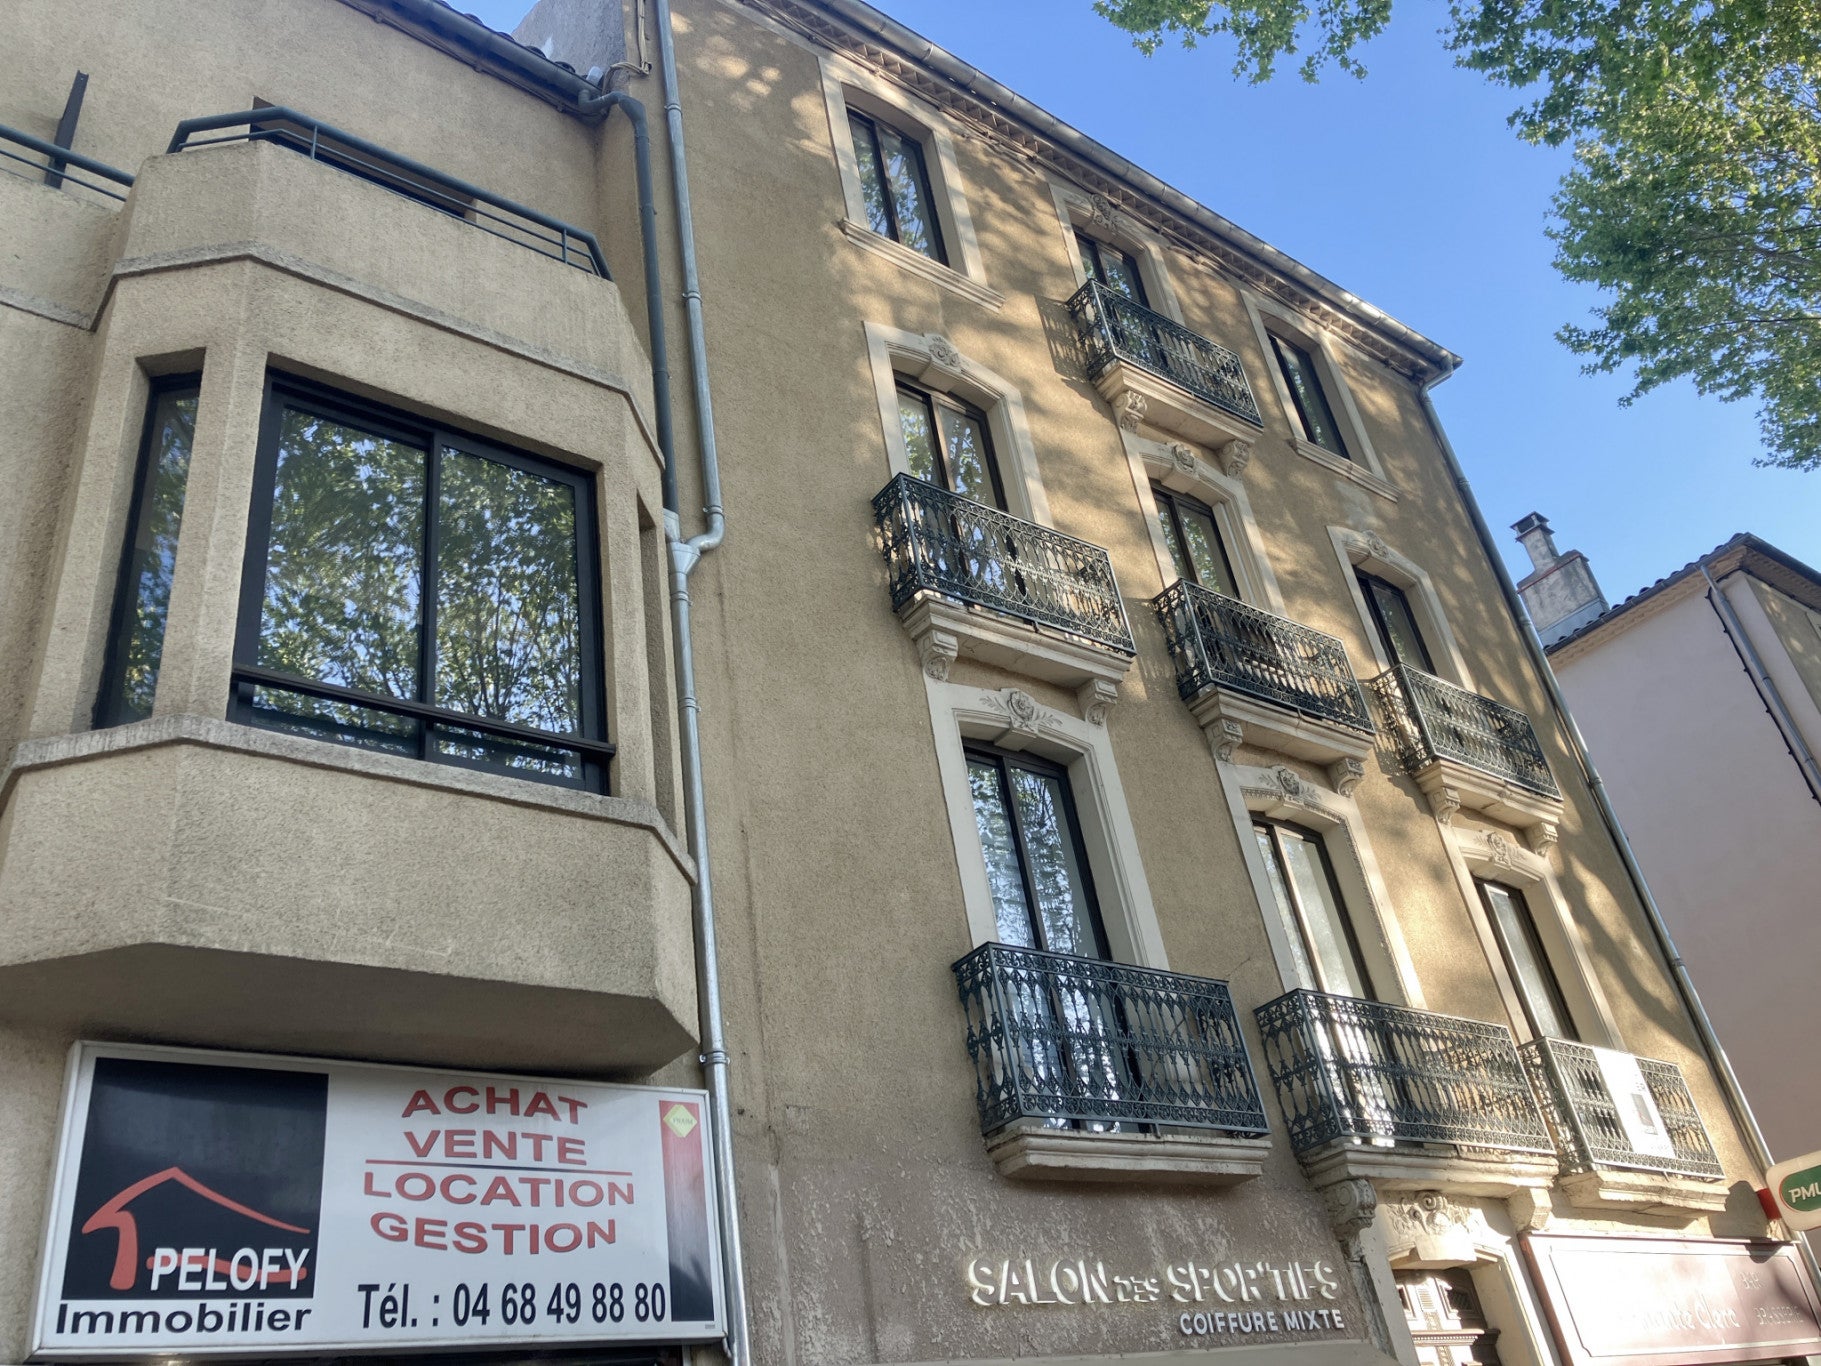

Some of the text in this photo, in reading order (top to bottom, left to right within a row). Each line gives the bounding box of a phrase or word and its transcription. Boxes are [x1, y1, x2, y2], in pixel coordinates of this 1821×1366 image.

[401, 1086, 588, 1125] ACHAT
[403, 1129, 588, 1166] VENTE
[363, 1171, 635, 1208] LOCATION
[369, 1212, 617, 1256] GESTION
[150, 1247, 310, 1291] PELOFY
[967, 1259, 1114, 1306] SALON
[55, 1302, 312, 1334] Immobilier
[357, 1282, 419, 1329] Tél.
[453, 1282, 491, 1327] 04
[501, 1282, 537, 1325] 68
[546, 1282, 582, 1324] 49
[591, 1282, 625, 1323] 88
[634, 1282, 667, 1322] 80
[1179, 1308, 1346, 1336] COIFFURE MIXTE
